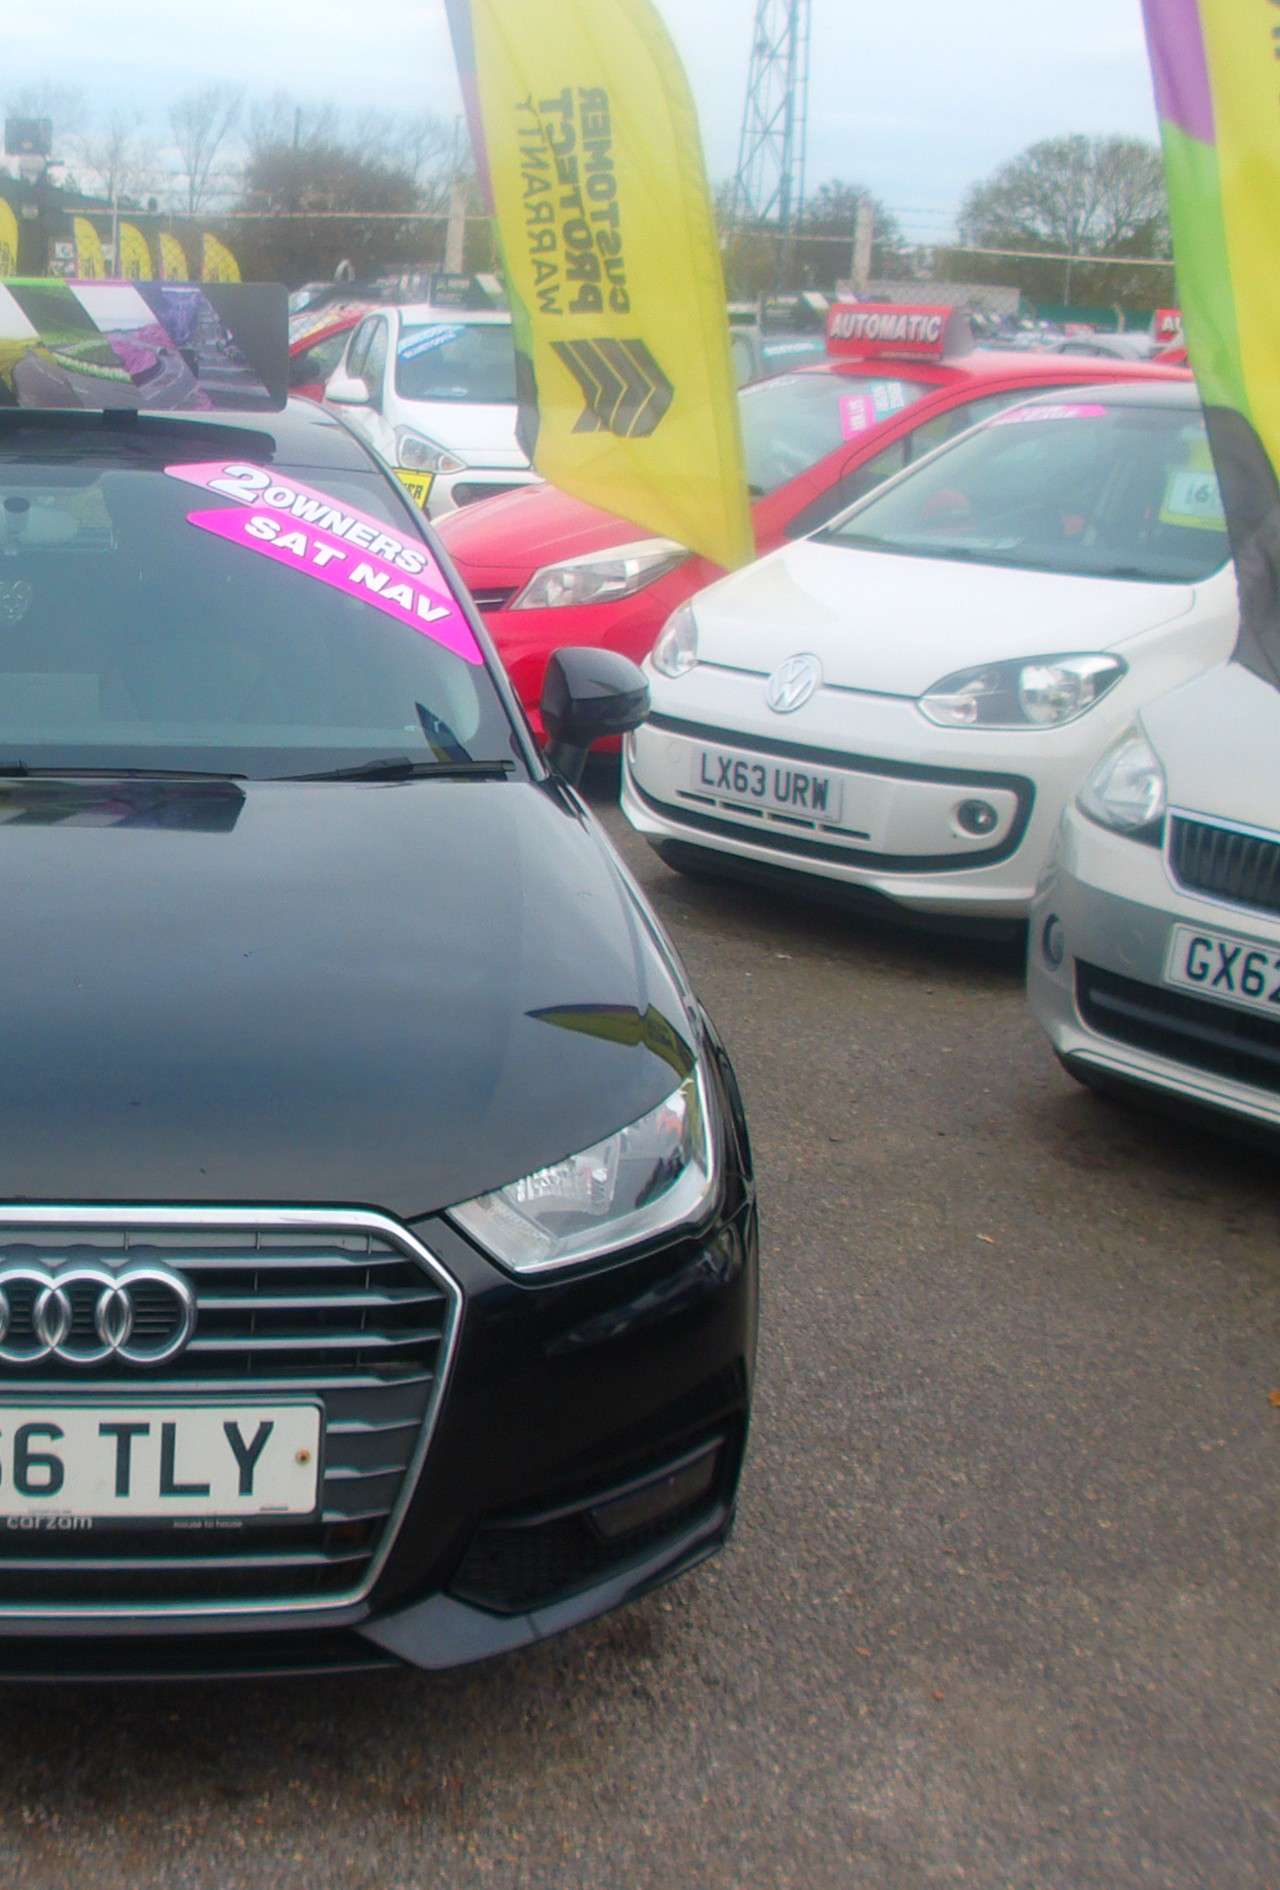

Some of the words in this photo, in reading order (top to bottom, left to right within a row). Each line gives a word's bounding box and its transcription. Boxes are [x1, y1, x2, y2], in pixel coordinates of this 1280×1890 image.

[829, 313, 943, 343] AUTOMATIC
[243, 515, 346, 568] SAT
[348, 561, 451, 623] NAV
[263, 485, 429, 575] OWNERS
[700, 751, 767, 798] LX63
[773, 768, 830, 812] URW
[98, 1420, 275, 1498] TLY
